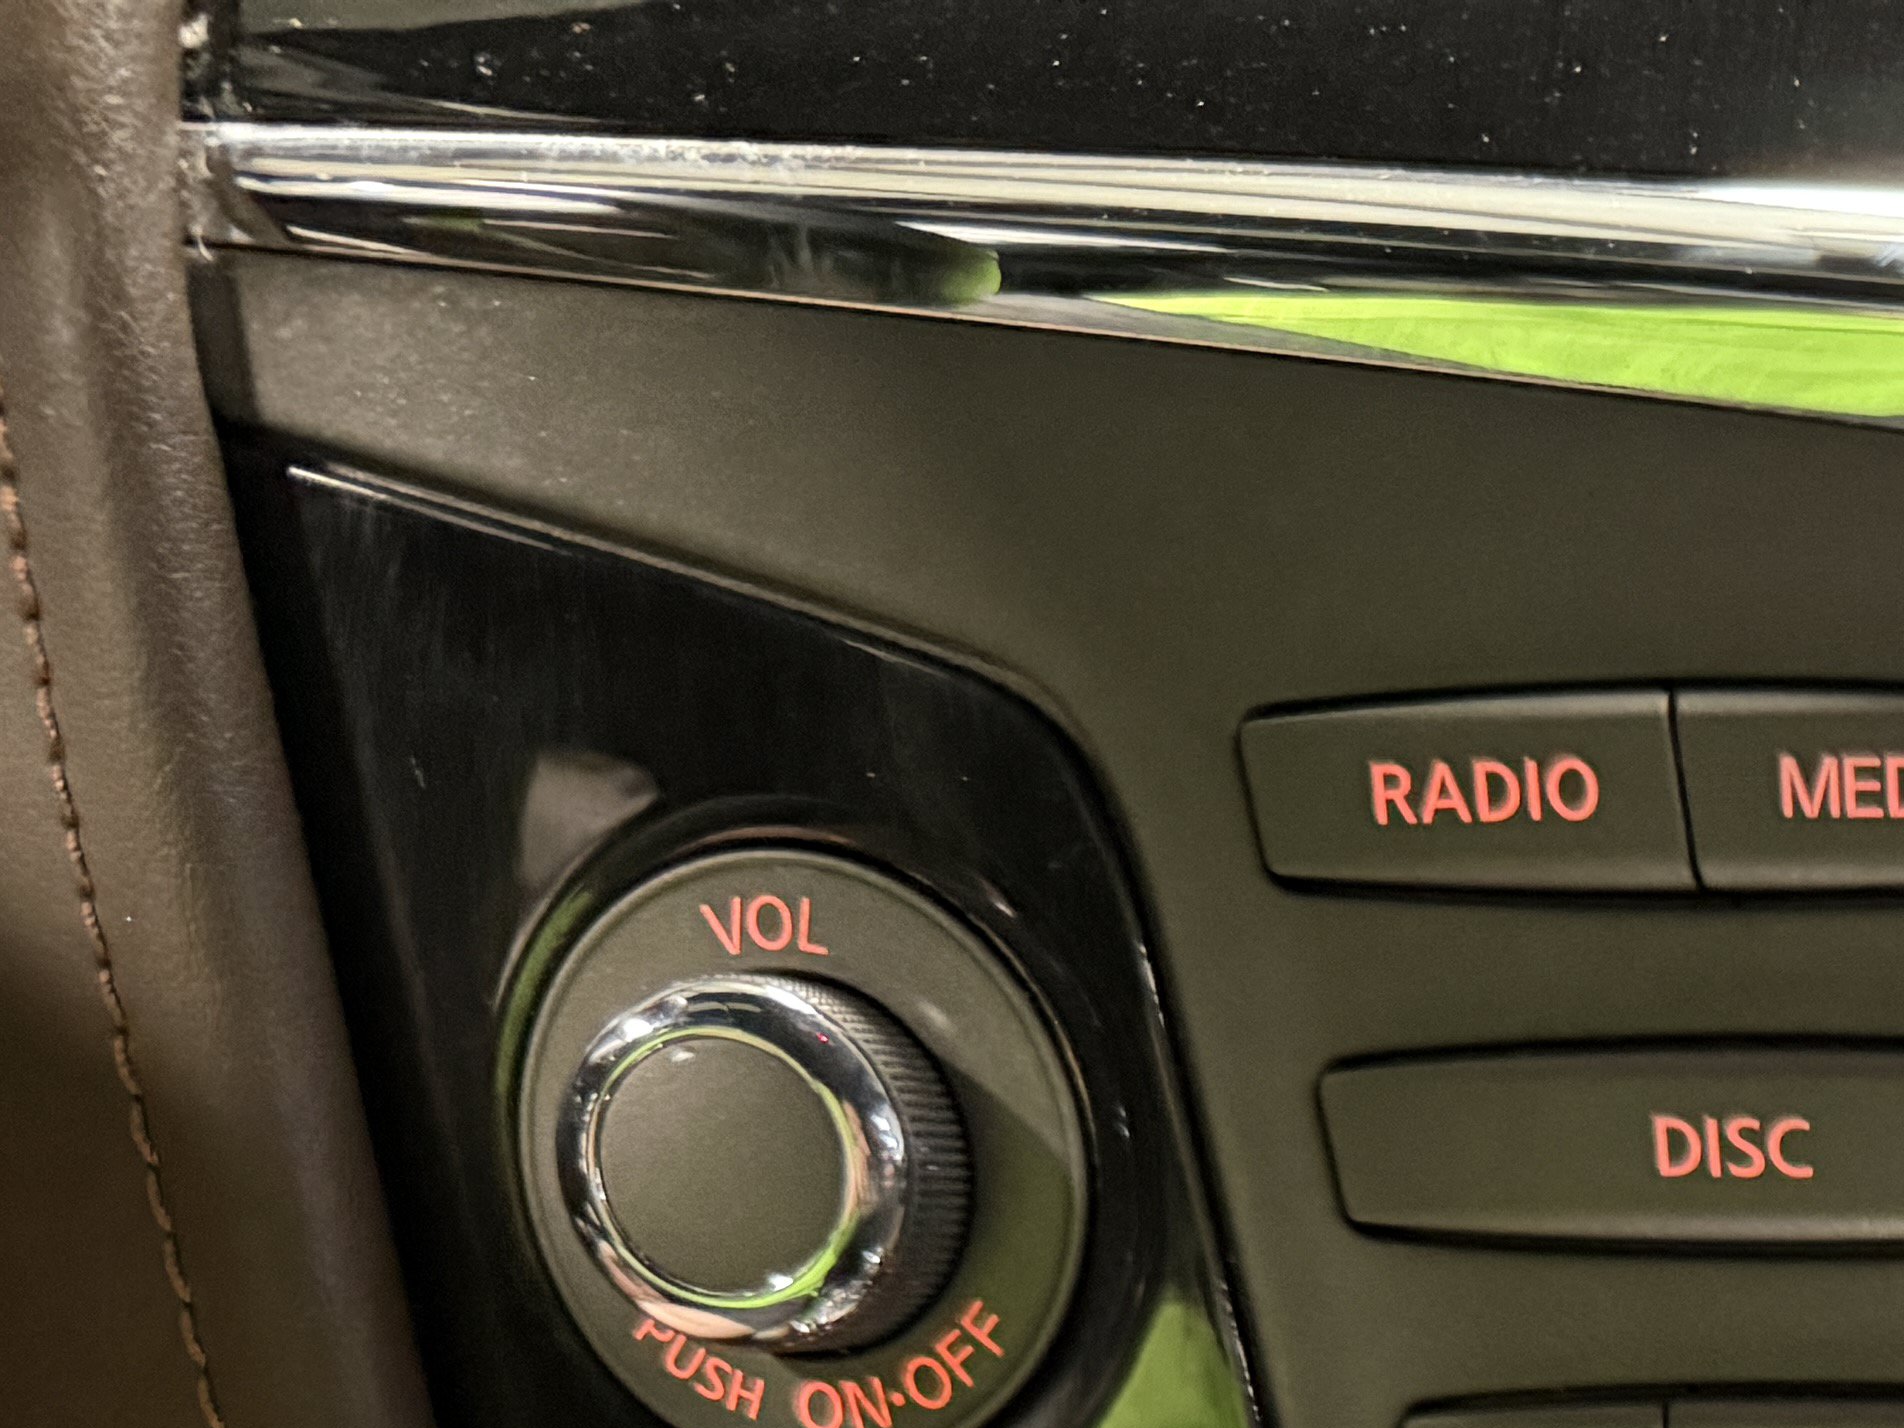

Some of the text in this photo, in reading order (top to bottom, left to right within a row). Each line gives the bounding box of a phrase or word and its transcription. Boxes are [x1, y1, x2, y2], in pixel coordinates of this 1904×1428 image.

[1369, 754, 1601, 827] RADIO
[699, 894, 829, 957] VOL
[1652, 1114, 1816, 1181] DISC
